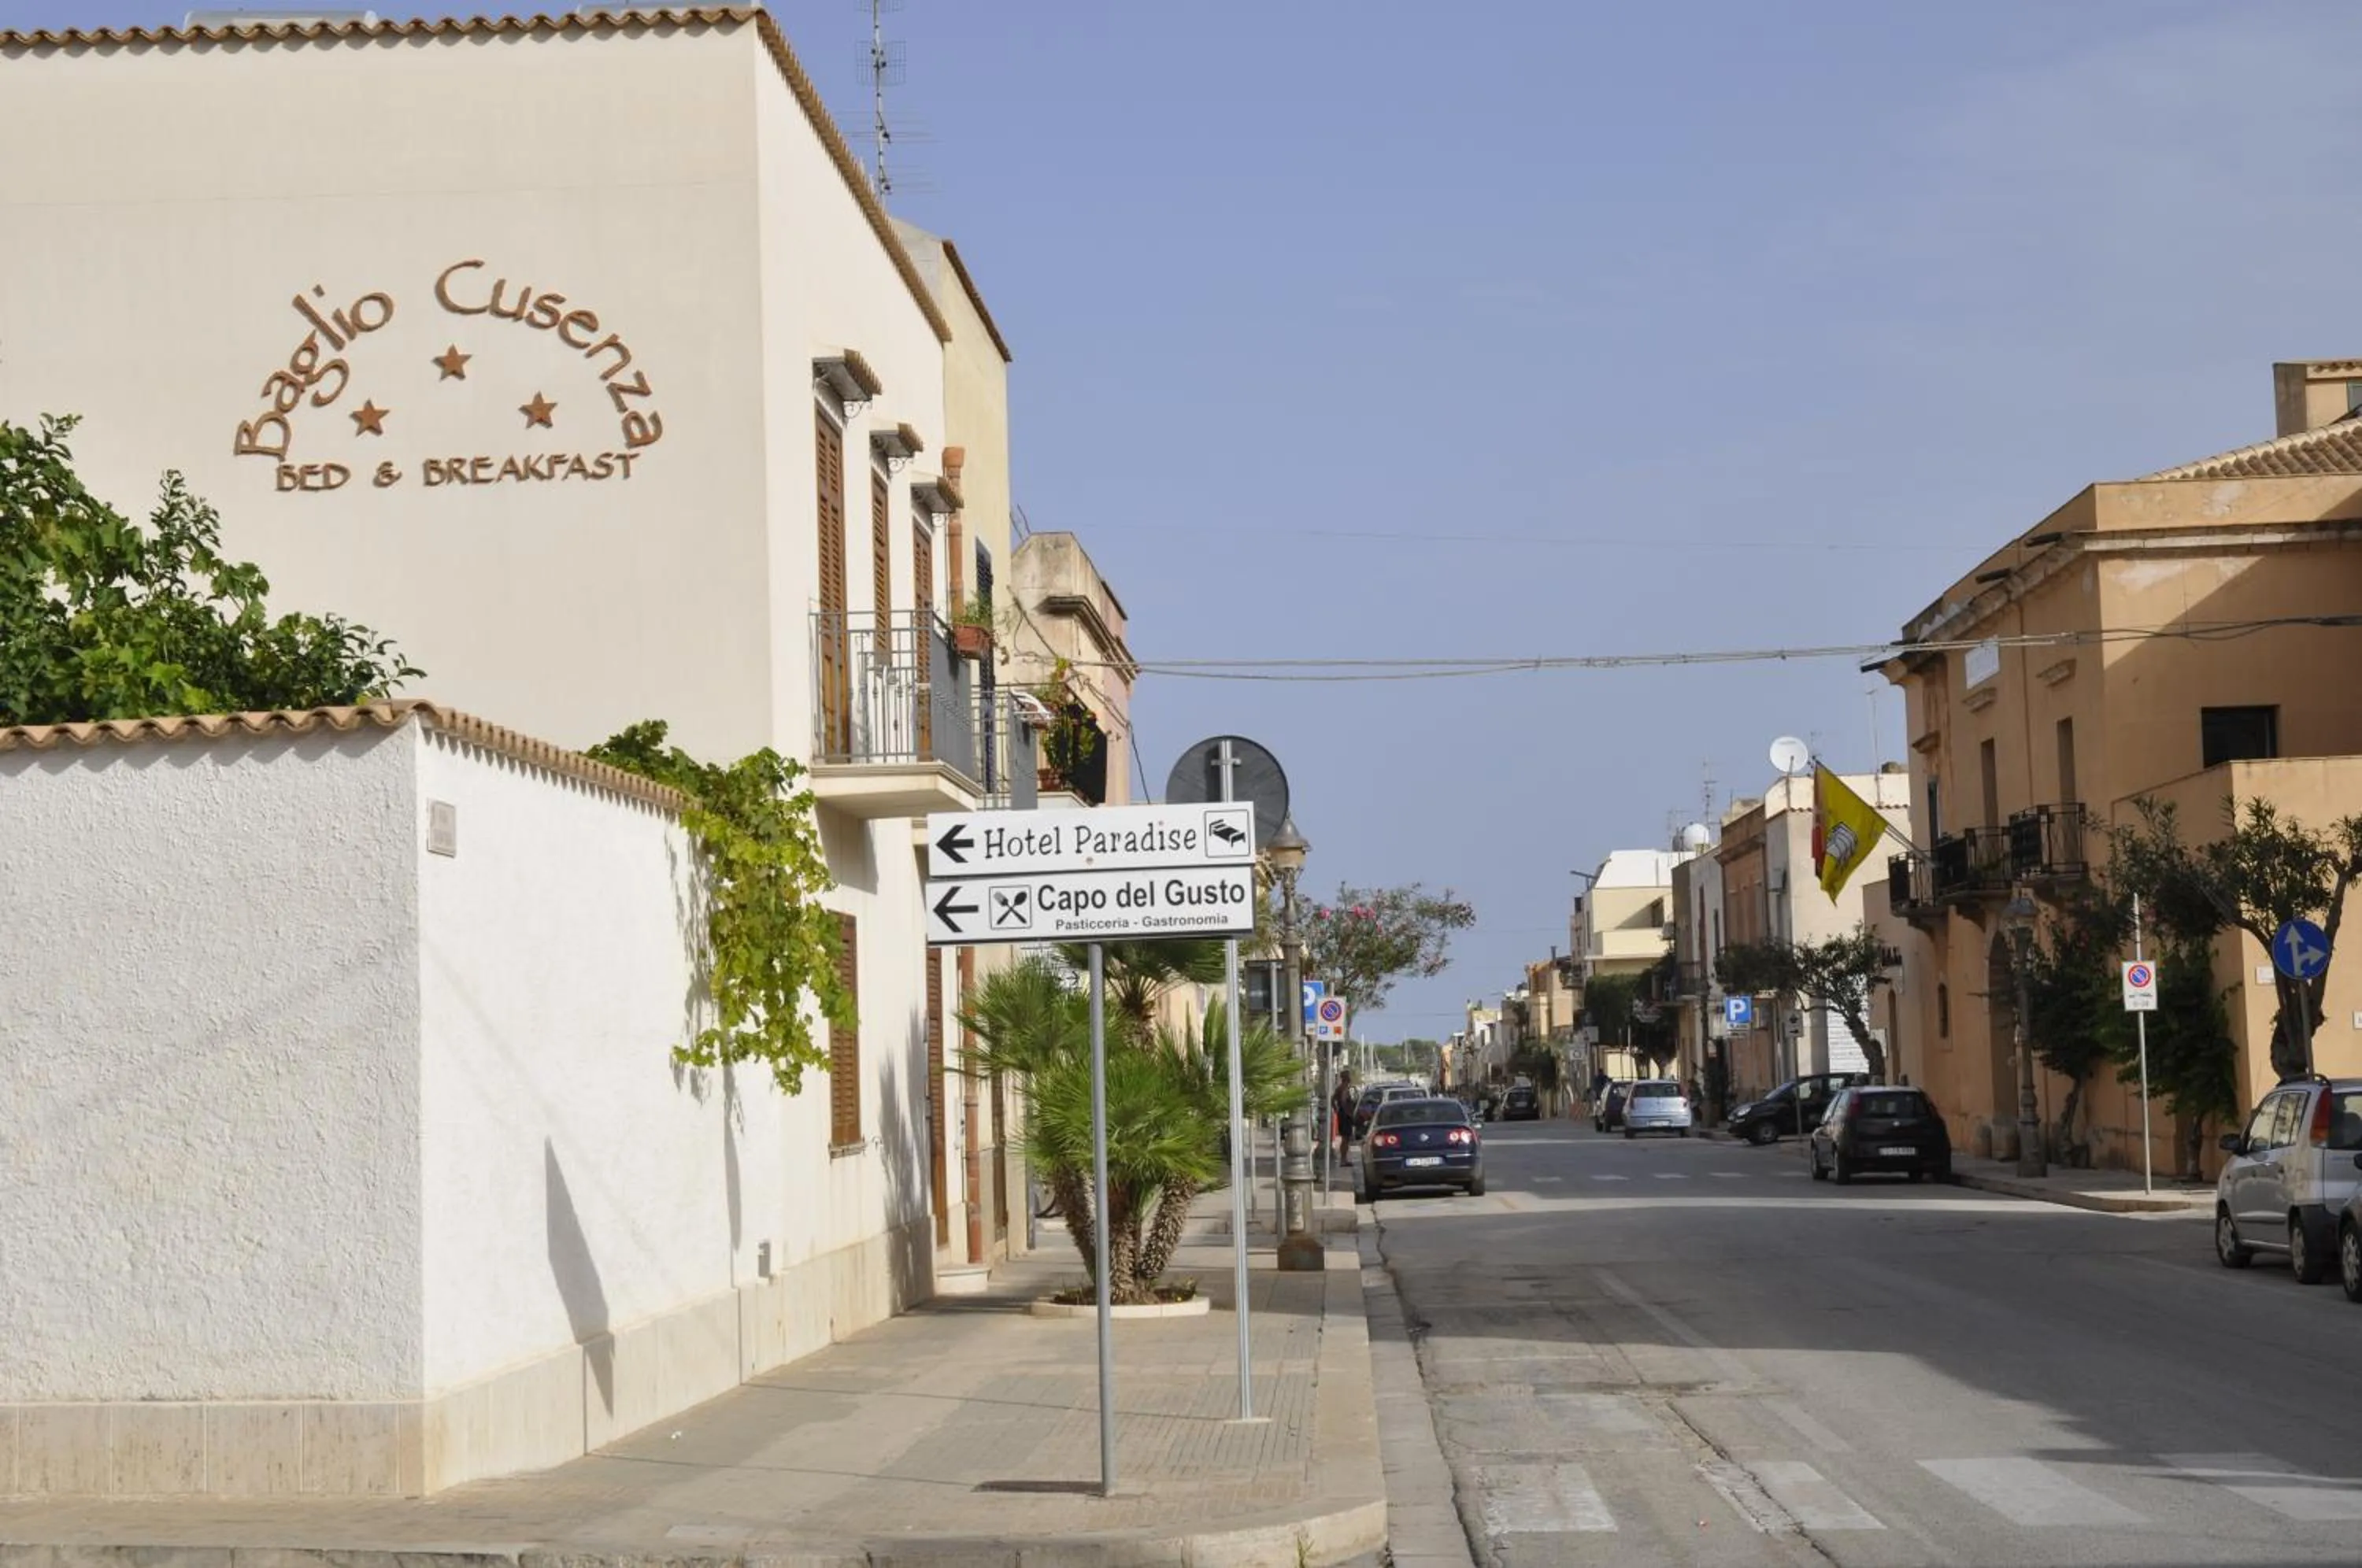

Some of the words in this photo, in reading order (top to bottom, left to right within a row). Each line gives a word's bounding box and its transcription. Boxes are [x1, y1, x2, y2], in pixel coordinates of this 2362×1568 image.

[234, 284, 394, 461] Baglio
[435, 259, 663, 449] Cusenza
[276, 462, 350, 491] BED
[372, 460, 402, 487] &
[423, 452, 639, 486] BREAKFAST
[983, 827, 1062, 859] Hotel
[1074, 823, 1197, 853] Paradise
[1037, 884, 1107, 917] Capo
[1116, 881, 1155, 908] del
[1164, 879, 1246, 906] Gusto
[1055, 917, 1129, 930] Pasticceria
[1142, 913, 1229, 928] Gastronomia
[1729, 999, 1746, 1021] P
